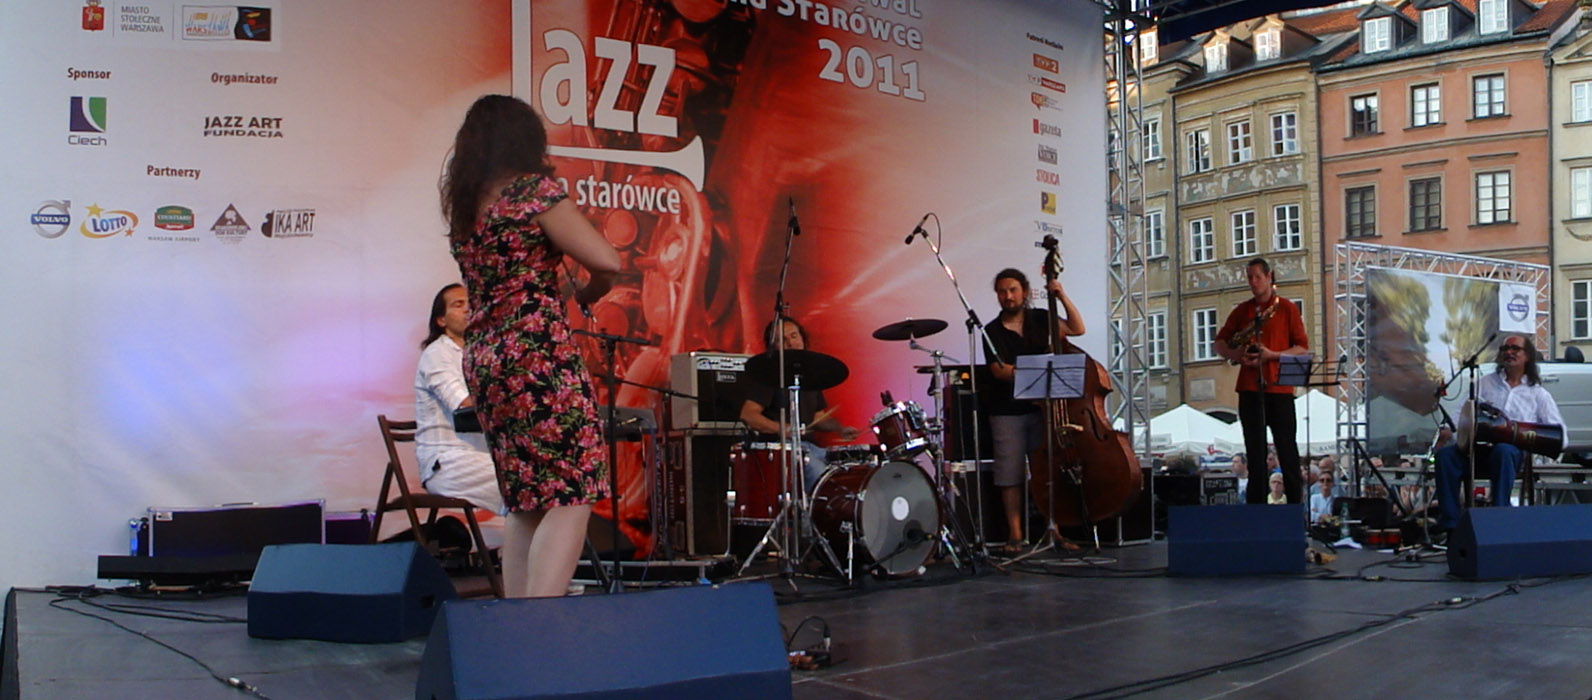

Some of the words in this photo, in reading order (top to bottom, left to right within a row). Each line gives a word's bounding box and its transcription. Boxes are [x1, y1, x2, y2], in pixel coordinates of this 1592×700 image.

[121, 6, 150, 14] MIASTO
[67, 67, 112, 81] Sponsor
[818, 38, 926, 102] 2011
[211, 72, 279, 86] Organizator
[204, 116, 243, 129] JAZZ
[248, 117, 283, 129] ART
[67, 135, 107, 146] Ciech
[203, 130, 284, 138] FUNDACJA
[147, 165, 201, 180] Partnerzy
[576, 174, 681, 214] starówce
[33, 215, 69, 223] VOLVO
[92, 216, 128, 232] LOTTO
